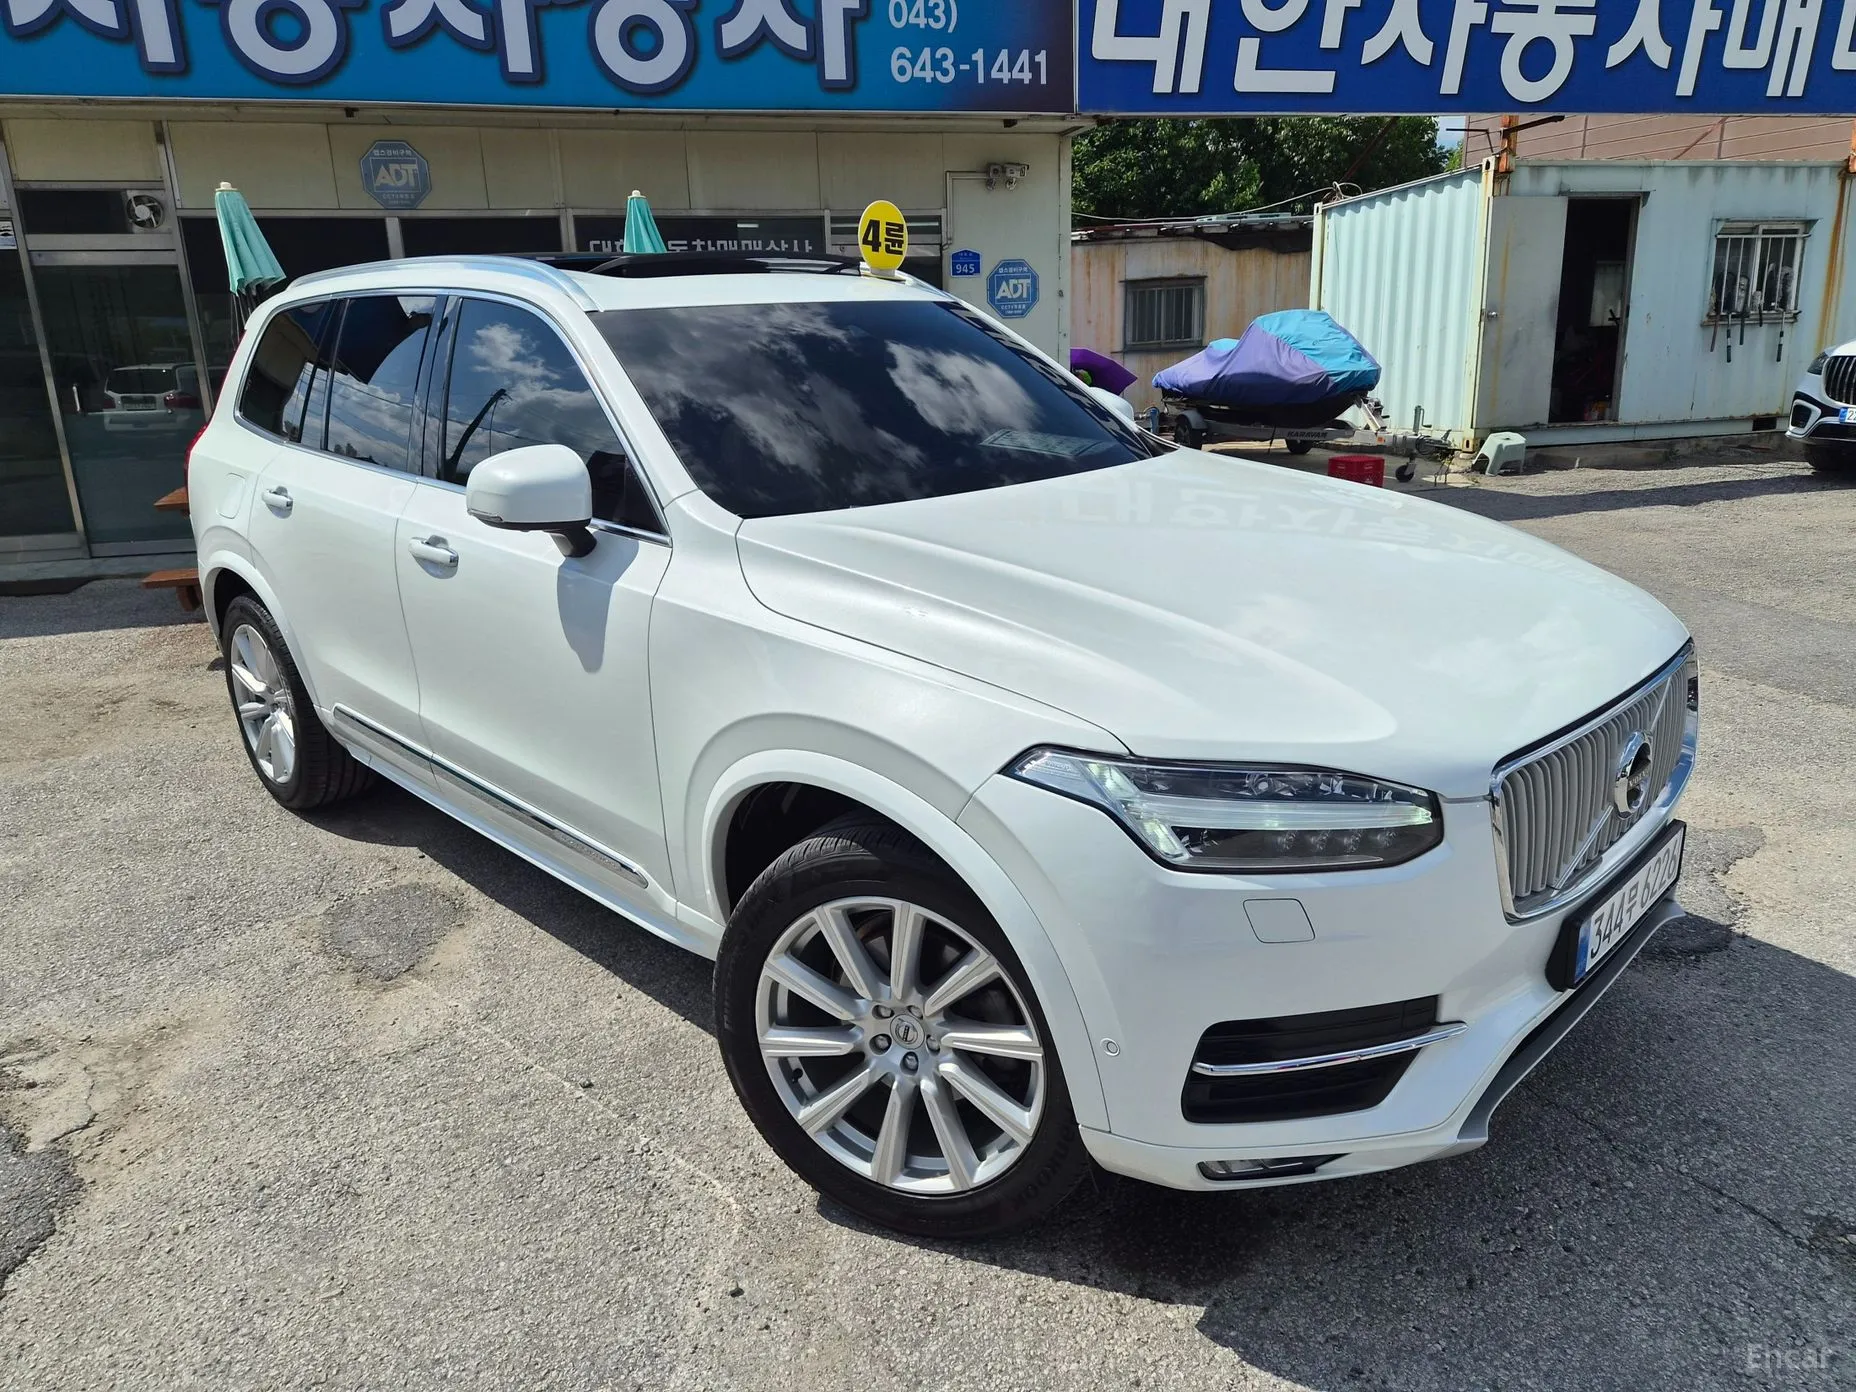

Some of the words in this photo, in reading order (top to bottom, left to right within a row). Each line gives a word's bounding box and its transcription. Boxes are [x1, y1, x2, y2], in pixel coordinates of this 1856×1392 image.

[889, 0, 959, 33] 043)
[891, 46, 1048, 86] 643-1441
[374, 164, 418, 188] ADT
[862, 219, 905, 256] 4륜
[955, 263, 975, 274] 945
[996, 279, 1031, 299] ADT
[1590, 881, 1640, 959] 344무
[1640, 839, 1679, 909] 6226
